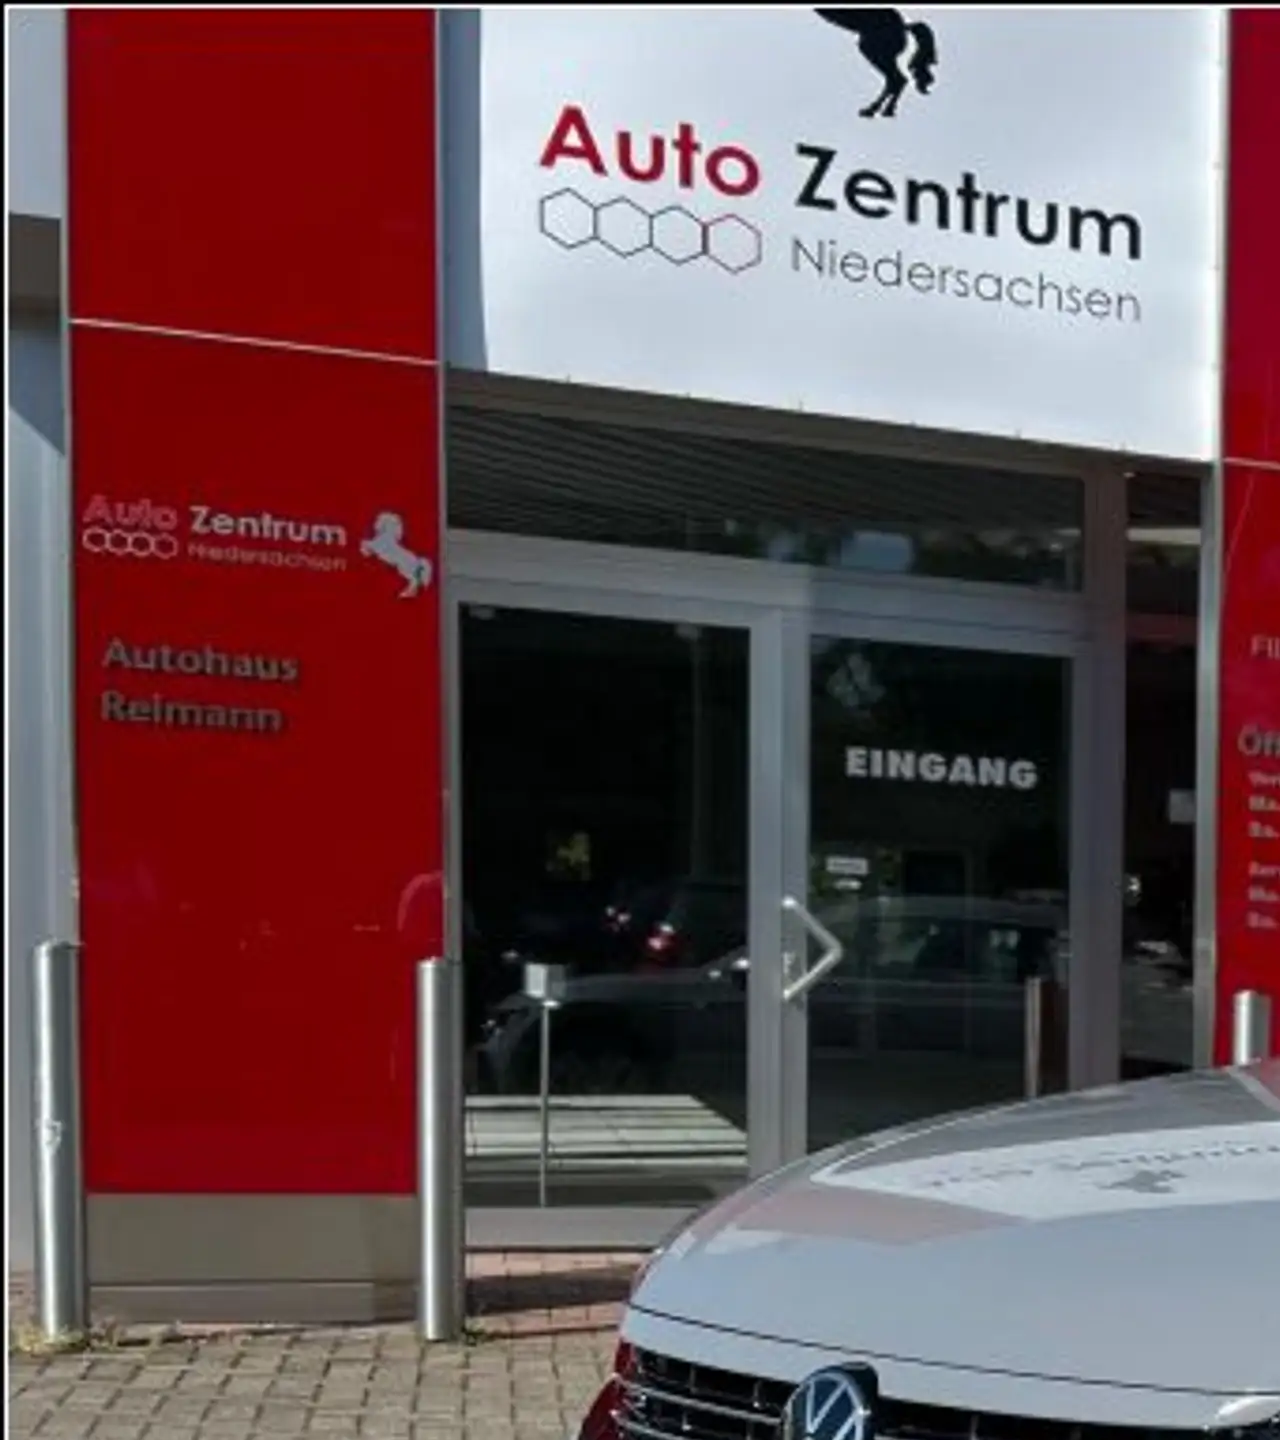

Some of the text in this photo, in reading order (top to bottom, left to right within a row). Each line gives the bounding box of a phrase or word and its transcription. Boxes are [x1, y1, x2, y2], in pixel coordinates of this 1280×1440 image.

[539, 104, 1143, 261] Auto Zentrum
[791, 238, 1143, 323] Niedersachsen
[82, 494, 348, 547] Auto Zentrum
[102, 636, 300, 682] Autohaus
[845, 746, 1040, 791] EINGANG
